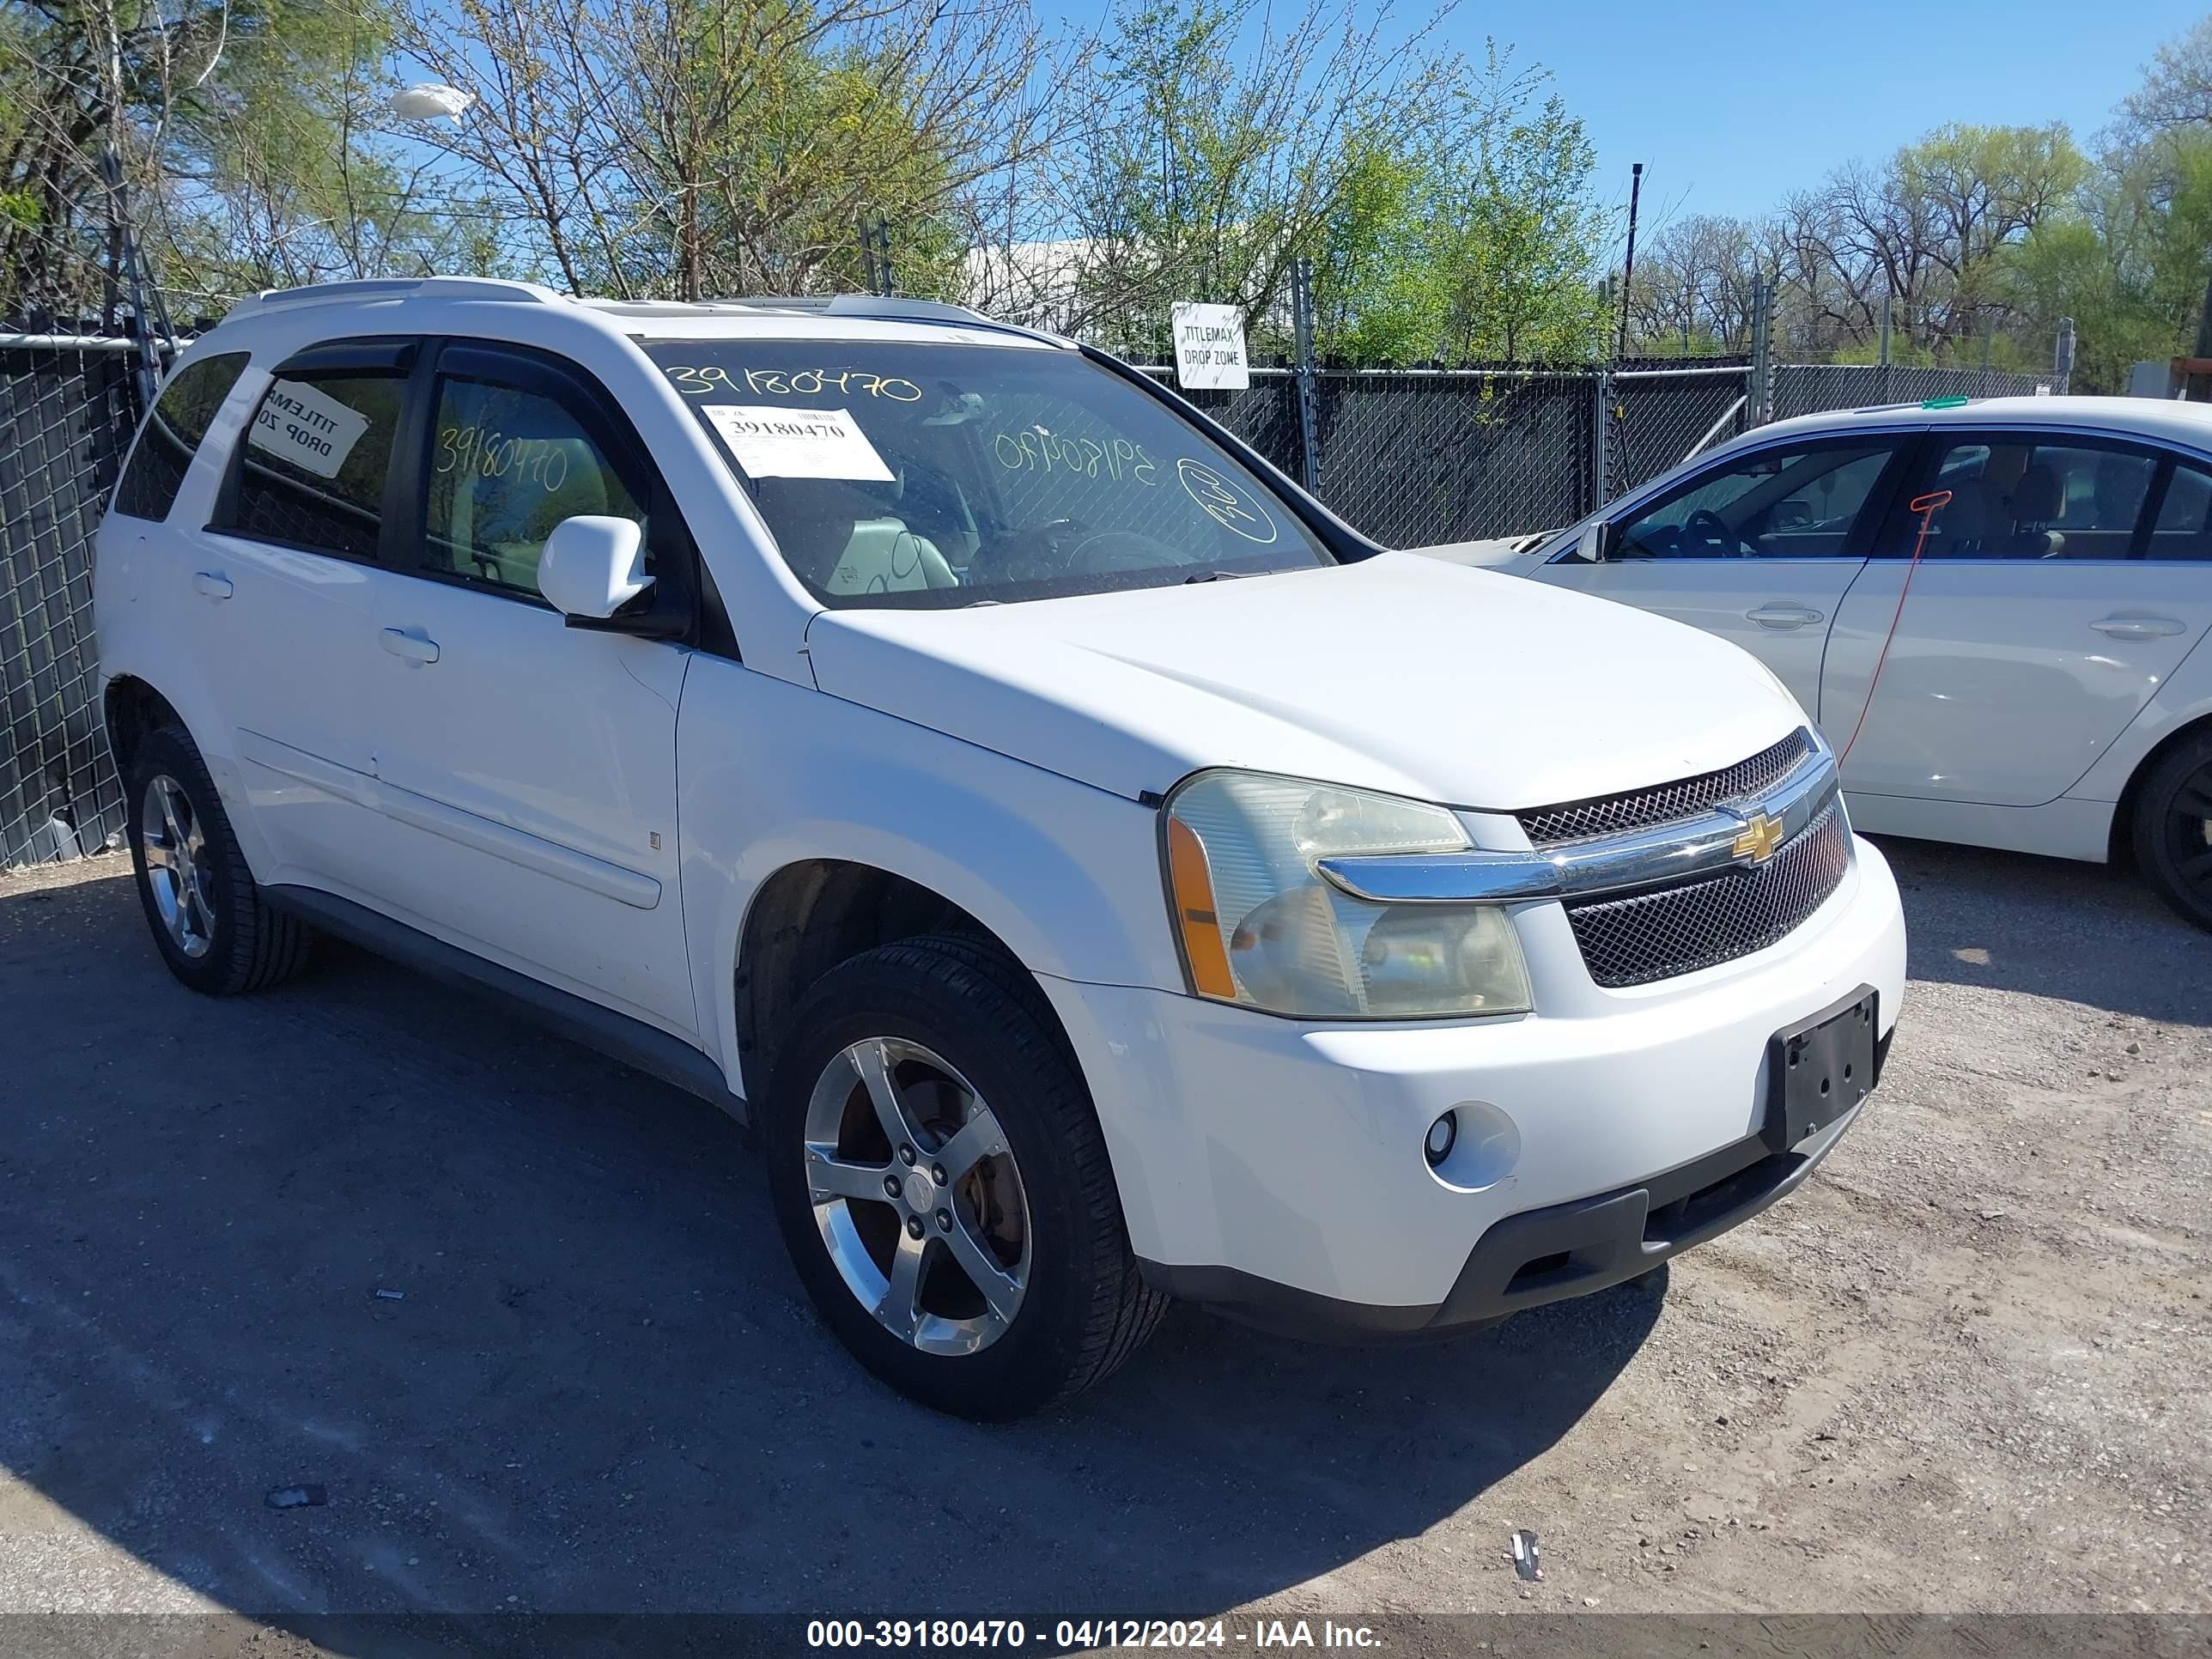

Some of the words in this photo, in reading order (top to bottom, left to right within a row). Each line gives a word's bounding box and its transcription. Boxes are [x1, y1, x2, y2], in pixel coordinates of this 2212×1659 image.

[1184, 325, 1234, 343] TITLEMAX
[1184, 349, 1212, 365] DROP
[1213, 350, 1239, 366] ZONE
[729, 420, 846, 439] 39180470
[436, 427, 568, 492] 39180470
